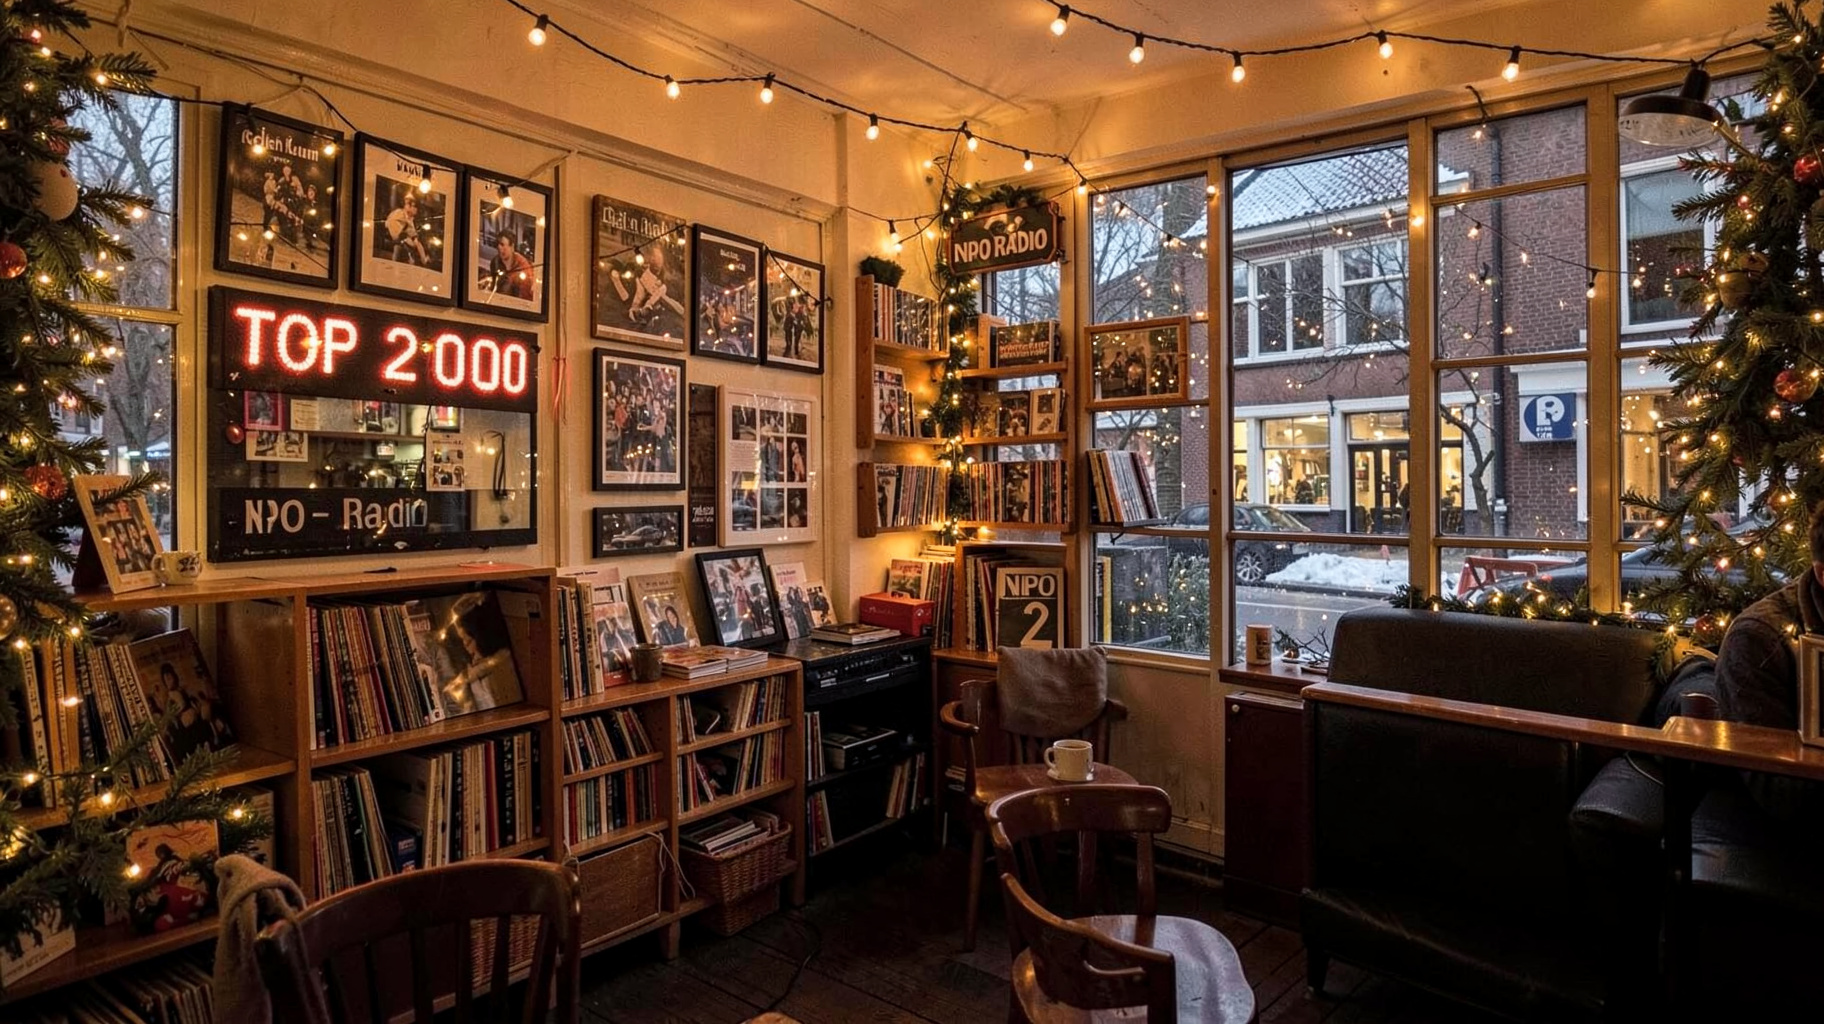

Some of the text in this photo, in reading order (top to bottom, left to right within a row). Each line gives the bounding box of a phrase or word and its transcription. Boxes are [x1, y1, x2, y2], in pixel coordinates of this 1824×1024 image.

[954, 228, 1048, 263] NPO RADIO
[235, 307, 358, 374] TOP
[244, 499, 305, 535] NPO
[343, 497, 428, 531] Radio
[1002, 575, 1056, 597] NPO
[1020, 601, 1053, 651] 2
